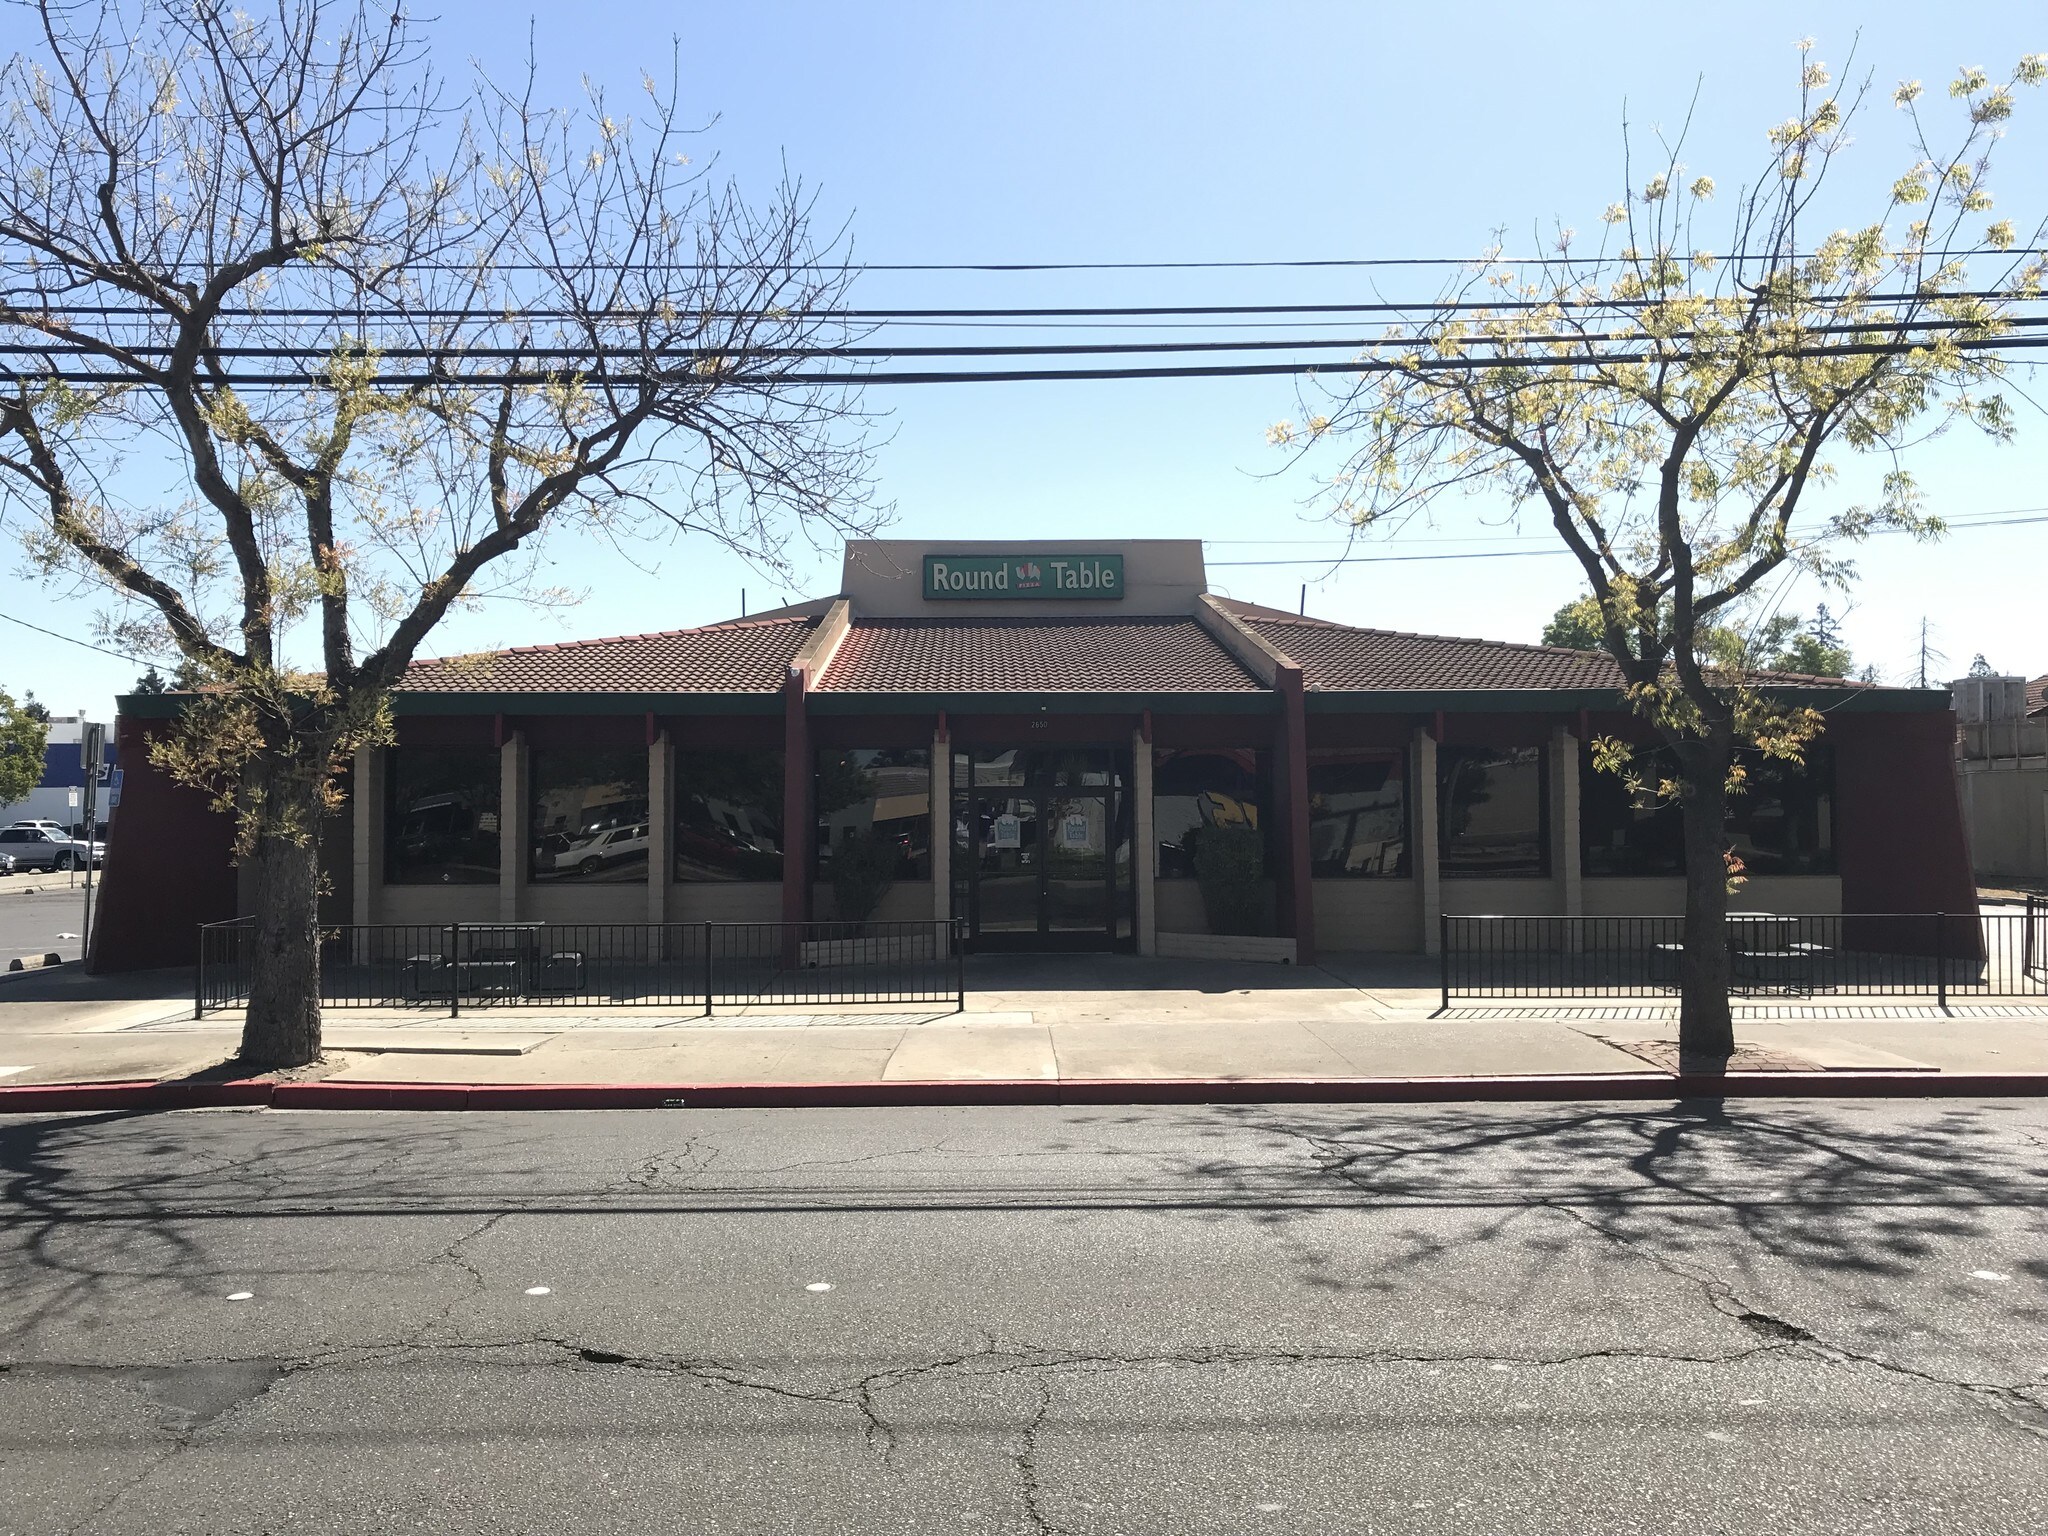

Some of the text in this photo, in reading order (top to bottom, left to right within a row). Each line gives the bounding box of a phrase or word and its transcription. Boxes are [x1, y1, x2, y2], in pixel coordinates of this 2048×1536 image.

[933, 562, 1115, 591] Round Table
[1018, 581, 1041, 589] PIZZA
